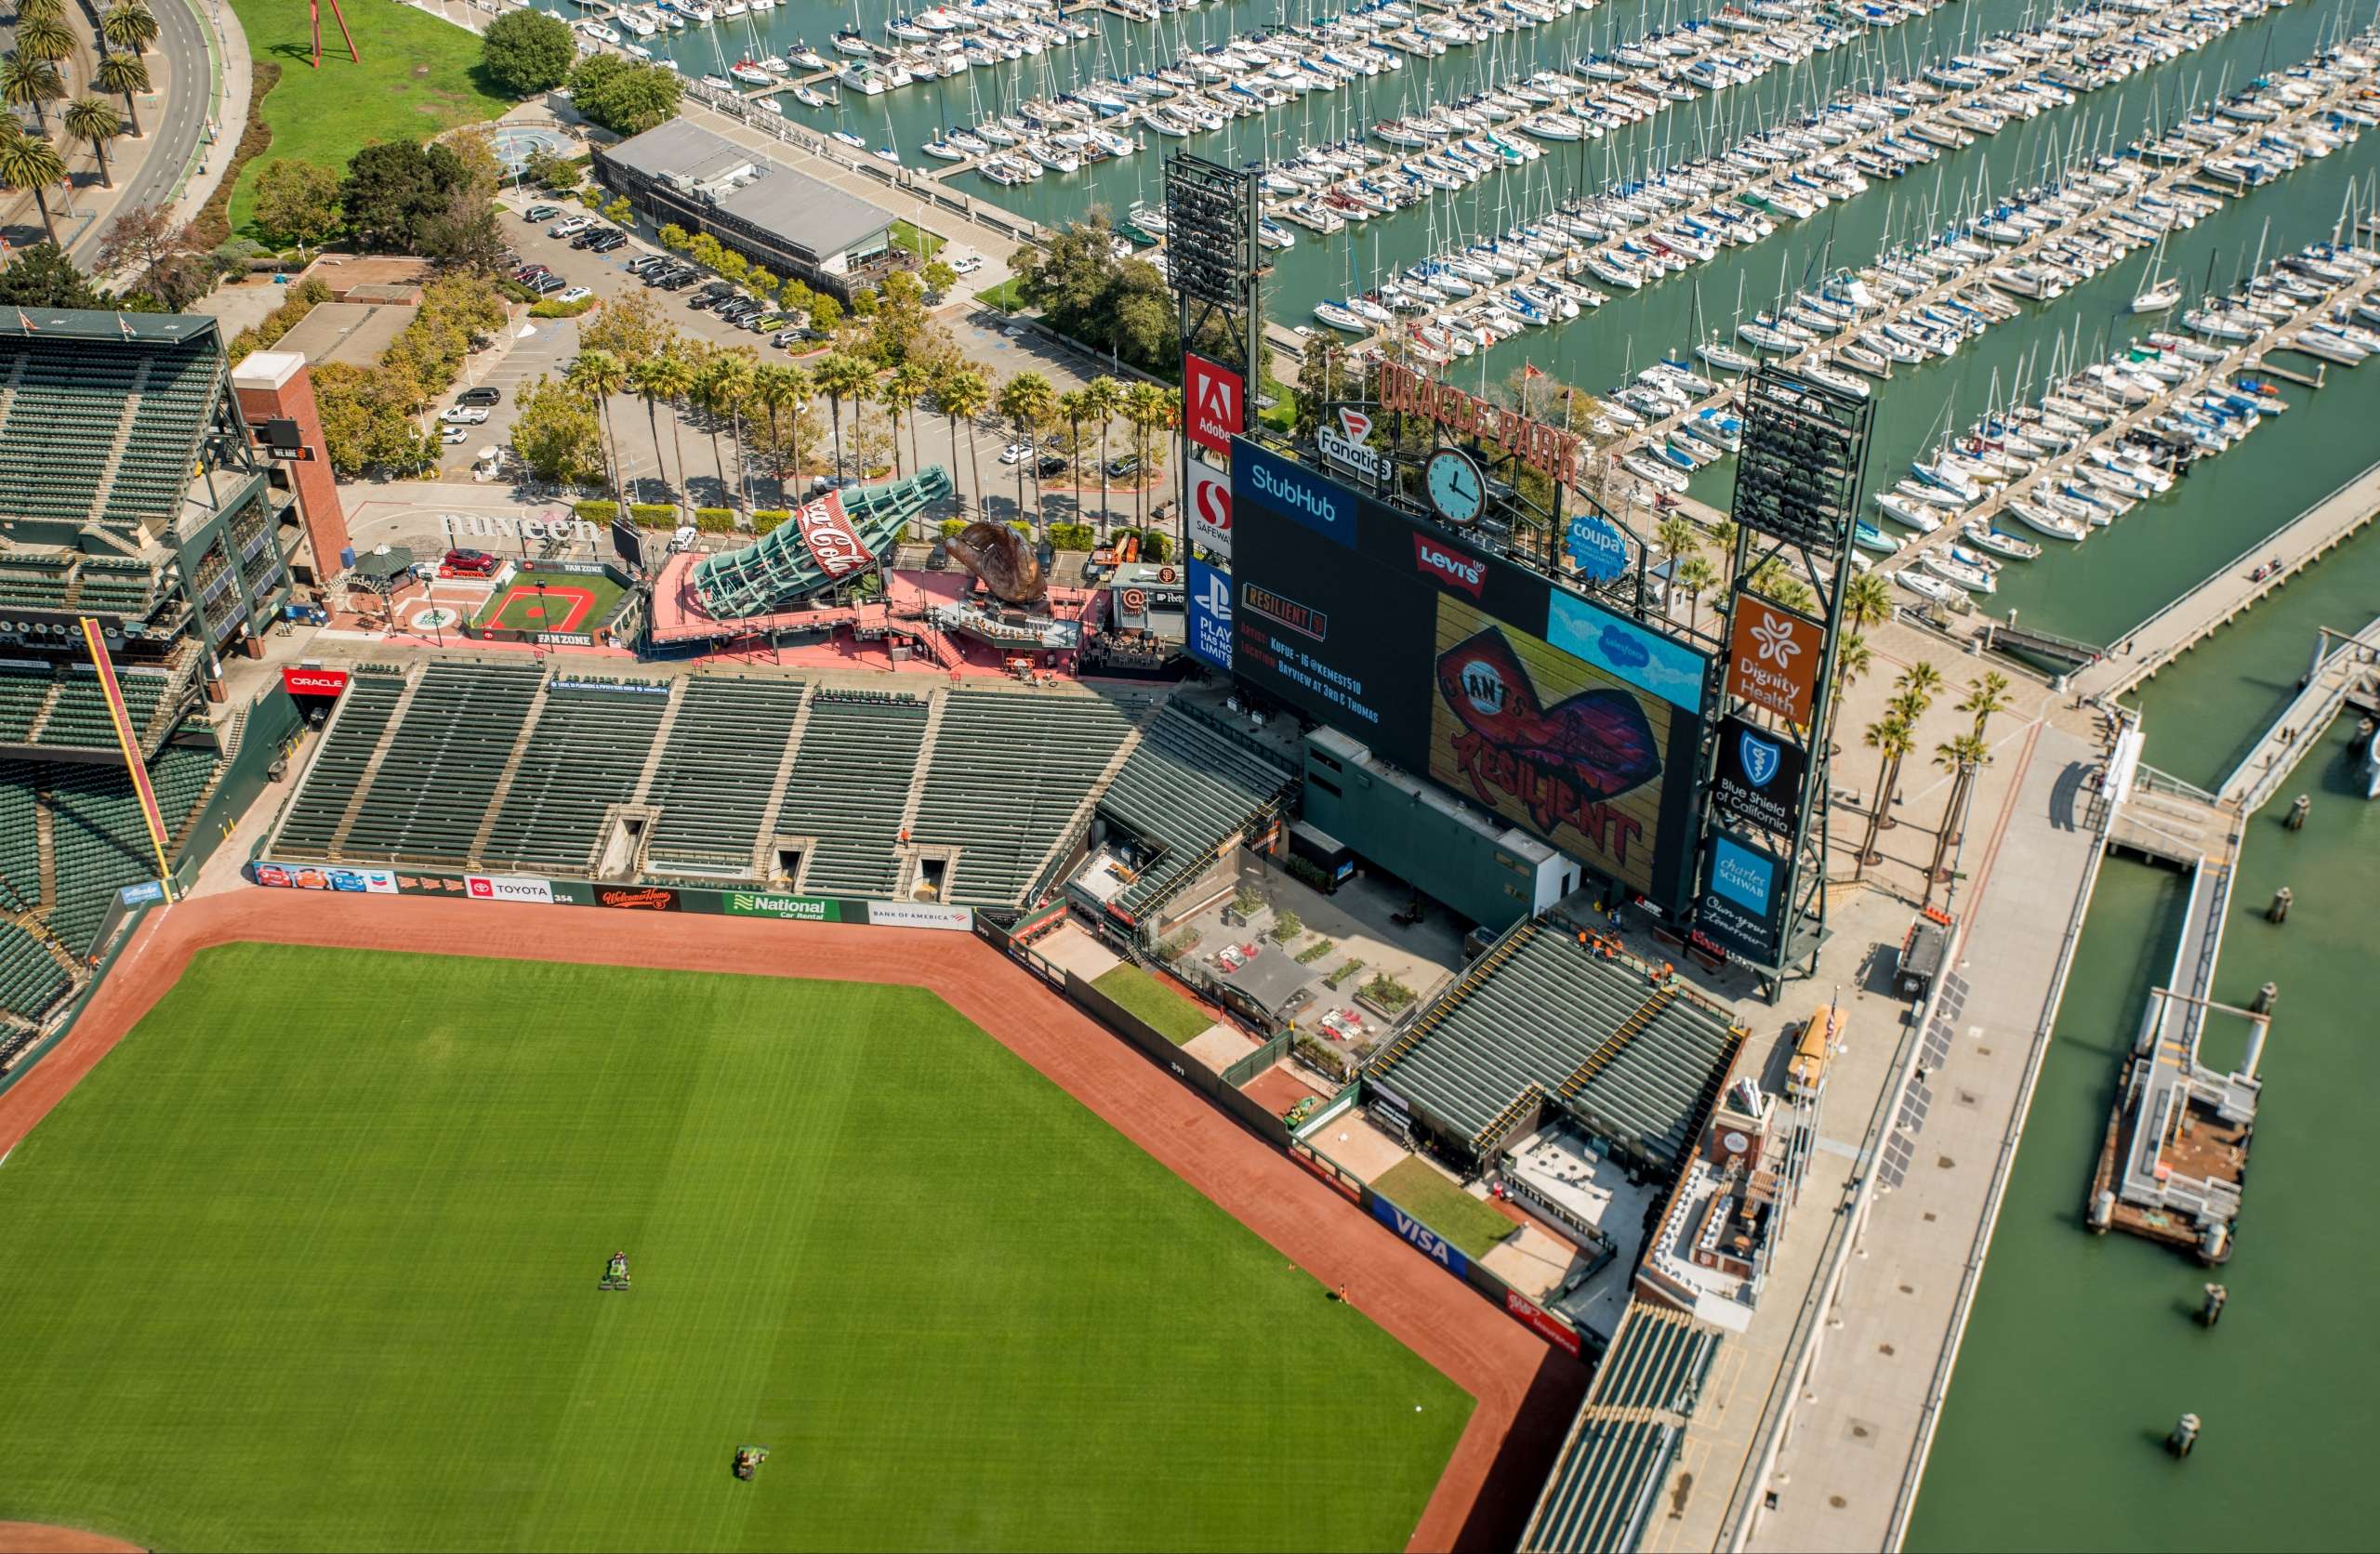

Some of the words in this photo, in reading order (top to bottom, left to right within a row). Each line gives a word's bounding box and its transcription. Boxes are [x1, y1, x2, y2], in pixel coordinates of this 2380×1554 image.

[1199, 417, 1231, 442] Adobe
[1380, 361, 1488, 440] ORACLE
[1498, 409, 1579, 491] PARK
[273, 448, 284, 457] WE
[284, 448, 298, 458] ARE
[1320, 430, 1388, 476] Fanatics
[1251, 465, 1336, 522] StubHub
[437, 514, 603, 543] nuveen
[801, 493, 868, 573] Coca-Cola
[1572, 523, 1620, 554] coupa
[565, 564, 581, 573] FAN
[581, 564, 603, 573] ZONE
[1250, 586, 1308, 626] RESILIENT
[537, 634, 561, 644] FAN
[561, 634, 591, 646] ZONE
[1199, 616, 1233, 641] PLAY
[1199, 632, 1218, 647] HAS
[1219, 639, 1233, 653] NO
[1199, 639, 1233, 665] LIMITS
[1271, 637, 1294, 660] KUFUE
[1606, 638, 1645, 661] salesforce
[291, 677, 343, 688] ORACLE
[1278, 660, 1312, 688] BAYVIEW
[1313, 680, 1322, 693] AT
[1324, 684, 1339, 702] 3RD
[1347, 696, 1379, 724] THOMAS
[1739, 656, 1801, 699] Dignity
[1442, 673, 1527, 718] GIANTS
[1740, 678, 1796, 717] Health
[1450, 730, 1644, 869] RESILIENT
[1715, 791, 1732, 807] of
[1731, 795, 1789, 834] California
[1721, 778, 1747, 799] Blue
[1749, 793, 1786, 819] Shield
[1719, 869, 1765, 898] SCHWAB
[1720, 858, 1765, 887] charles
[496, 884, 548, 897] TOYOTA
[602, 890, 643, 905] Welcome
[640, 888, 671, 902] Home
[755, 897, 826, 914] National
[797, 913, 824, 921] Rental
[873, 911, 896, 919] BANK
[910, 913, 949, 921] AMERICA
[1706, 895, 1735, 918] Own
[1735, 916, 1767, 935] your
[1691, 928, 1726, 956] Coors
[1704, 910, 1769, 948] tomorrow
[1391, 1207, 1449, 1265] VISA
[1533, 1317, 1578, 1353] Insurance
